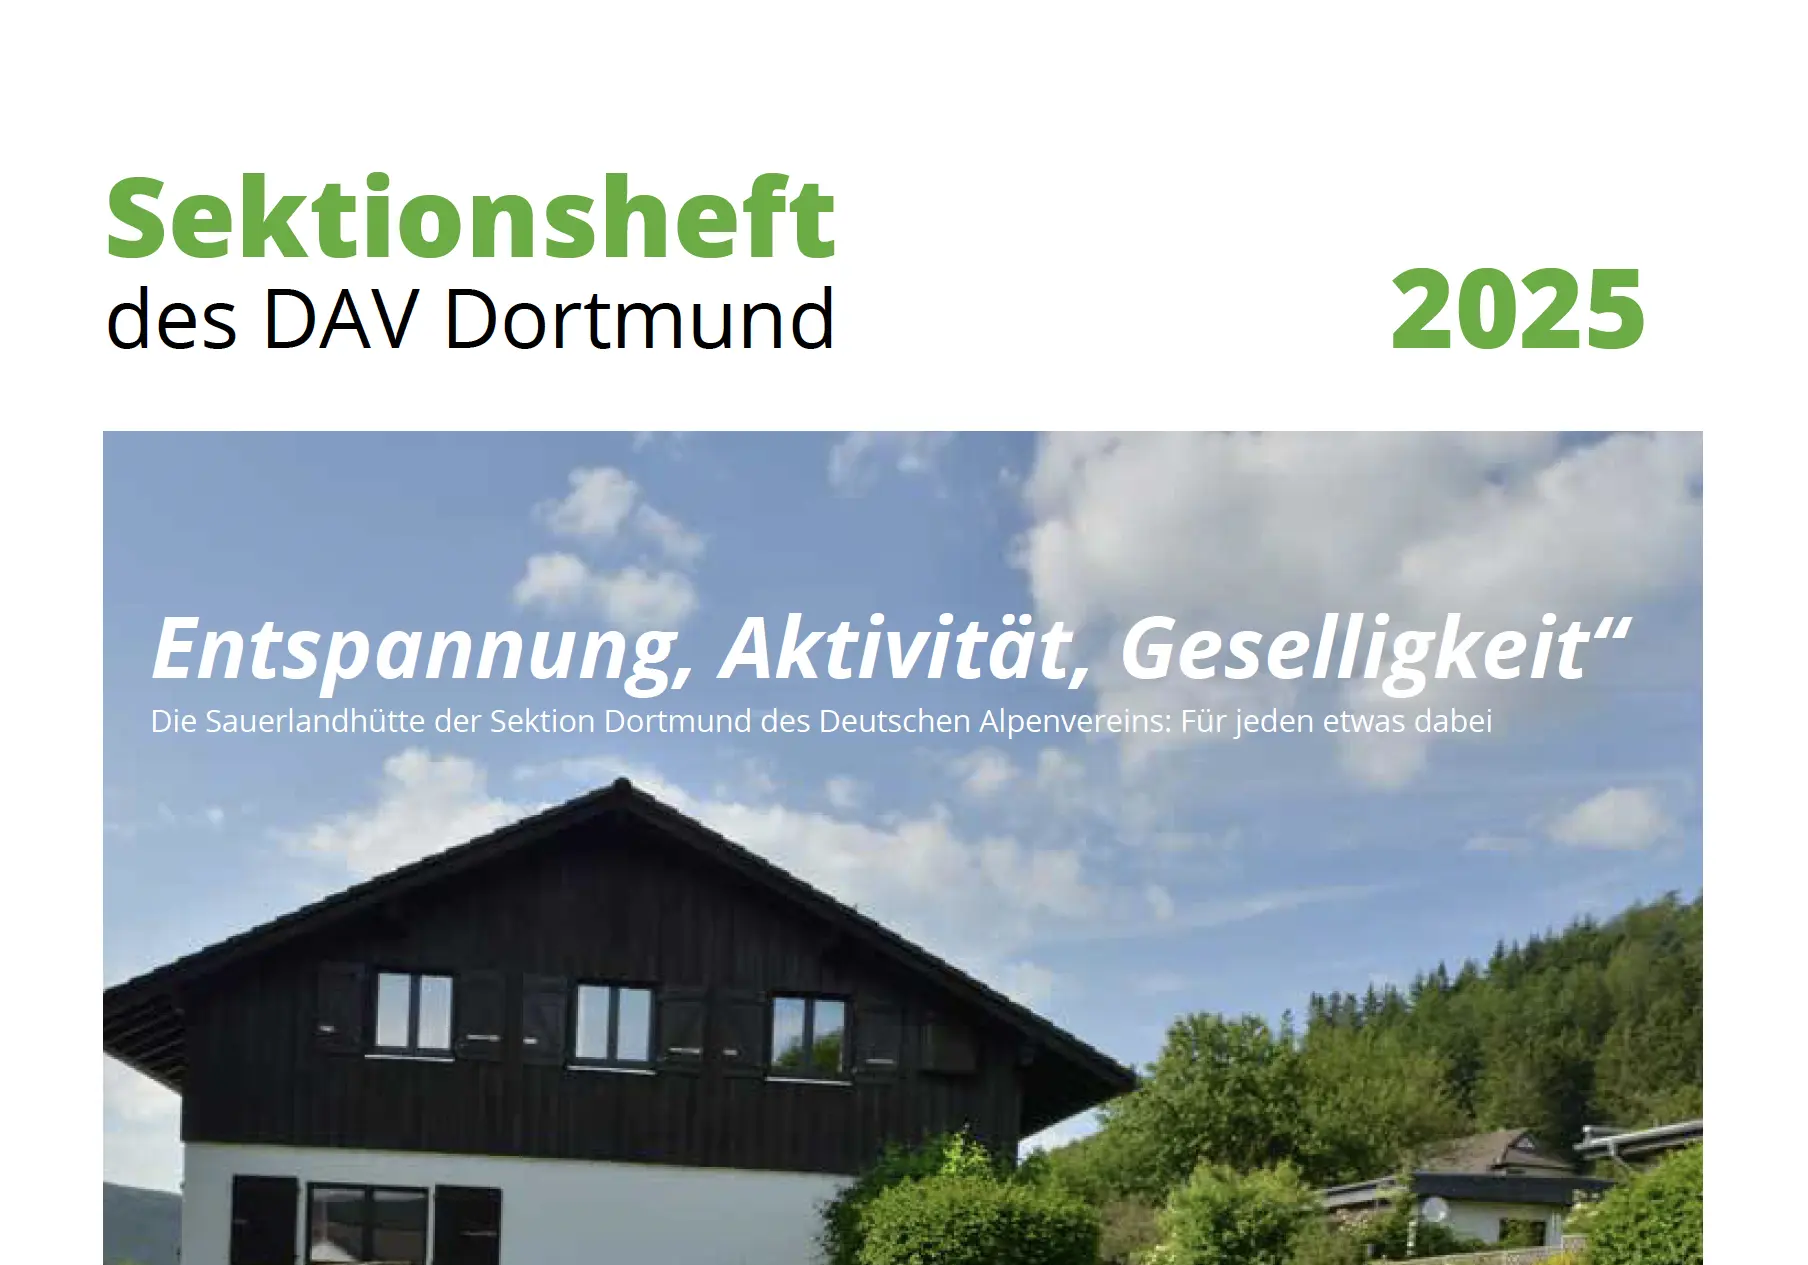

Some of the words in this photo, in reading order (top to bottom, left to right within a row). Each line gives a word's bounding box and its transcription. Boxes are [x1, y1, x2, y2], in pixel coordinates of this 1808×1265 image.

[108, 172, 834, 258] Sektionsheft
[108, 286, 236, 349] des
[268, 289, 420, 348] DAV
[449, 286, 832, 349] Dortmund
[1392, 268, 1644, 349] 2025
